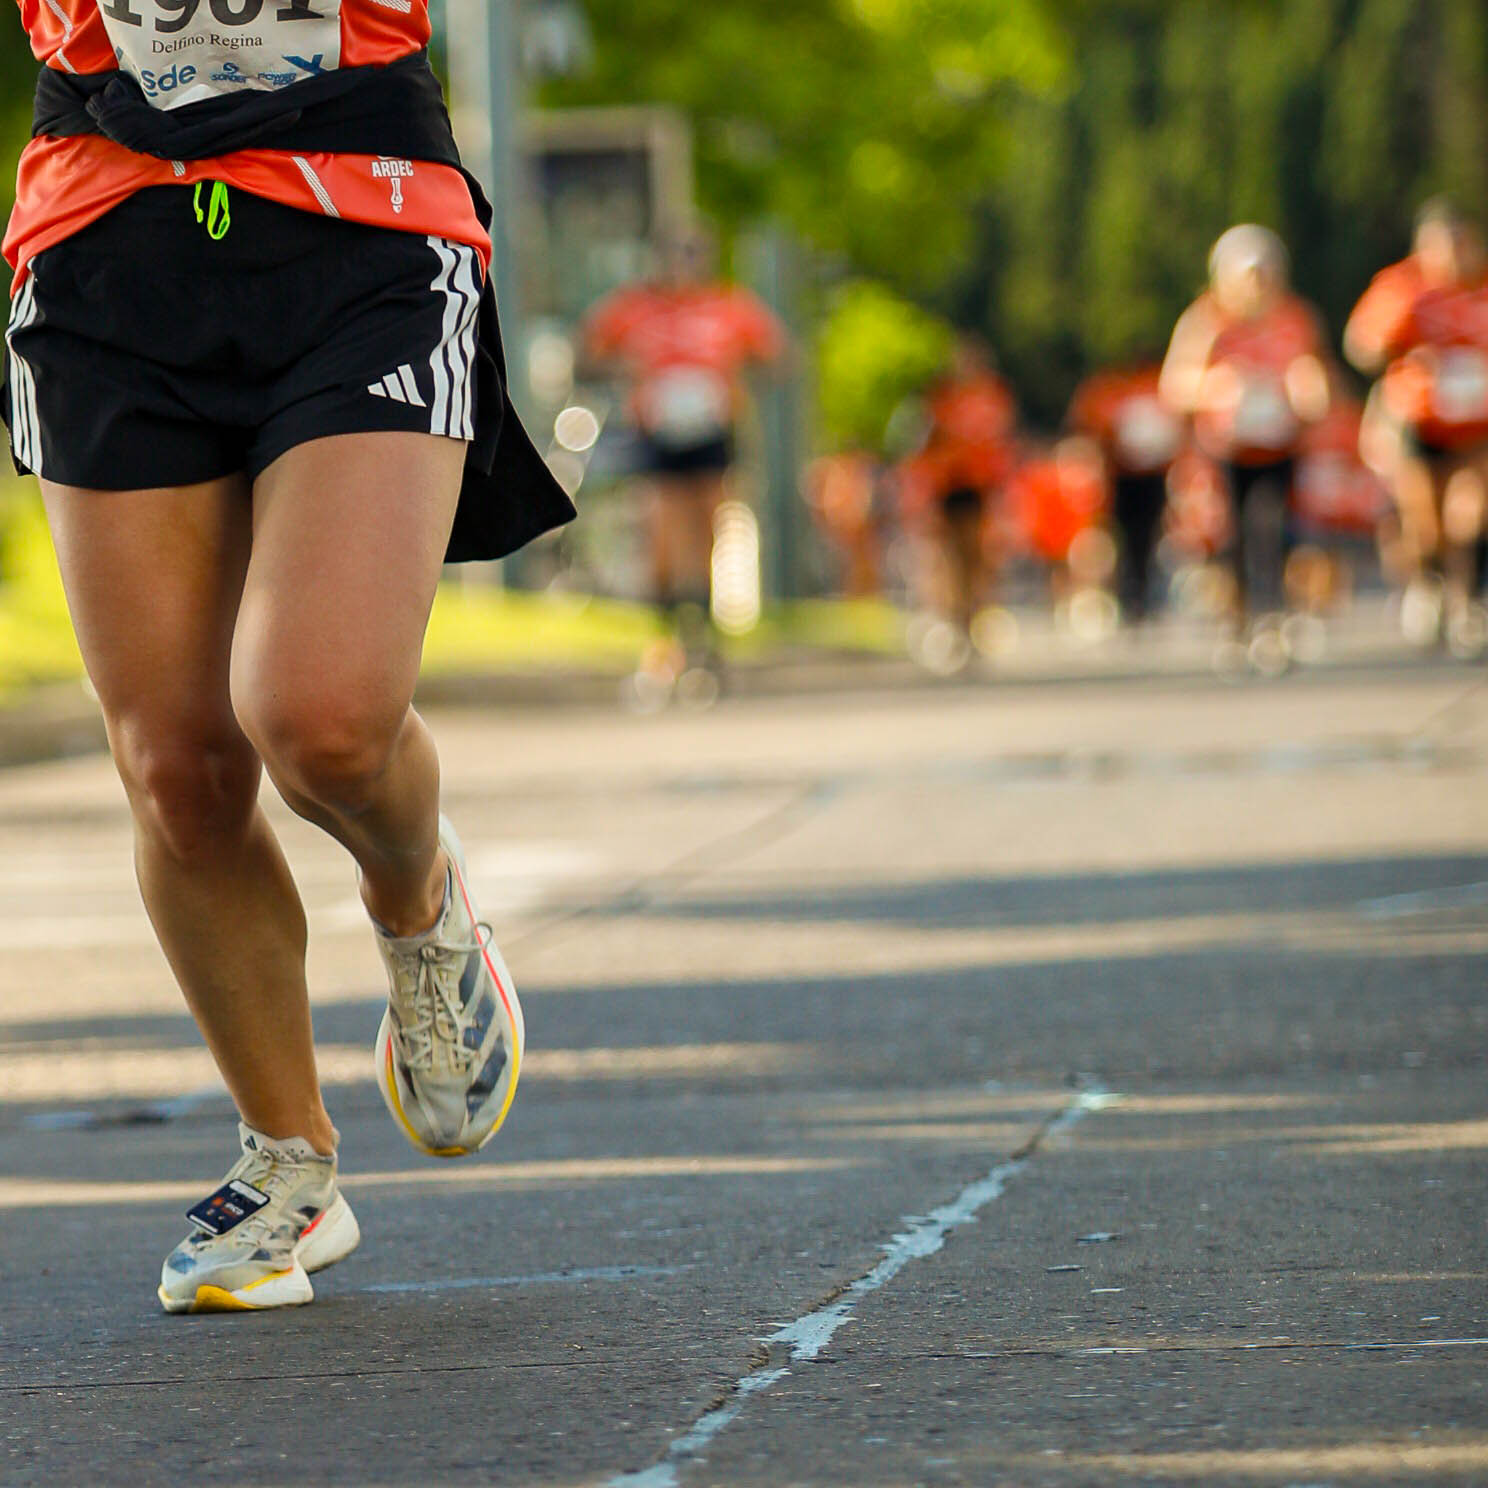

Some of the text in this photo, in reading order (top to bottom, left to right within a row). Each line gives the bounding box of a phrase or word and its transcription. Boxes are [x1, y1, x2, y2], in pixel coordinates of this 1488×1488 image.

[152, 33, 263, 54] Delfino Regina
[372, 159, 414, 177] ARDEC
